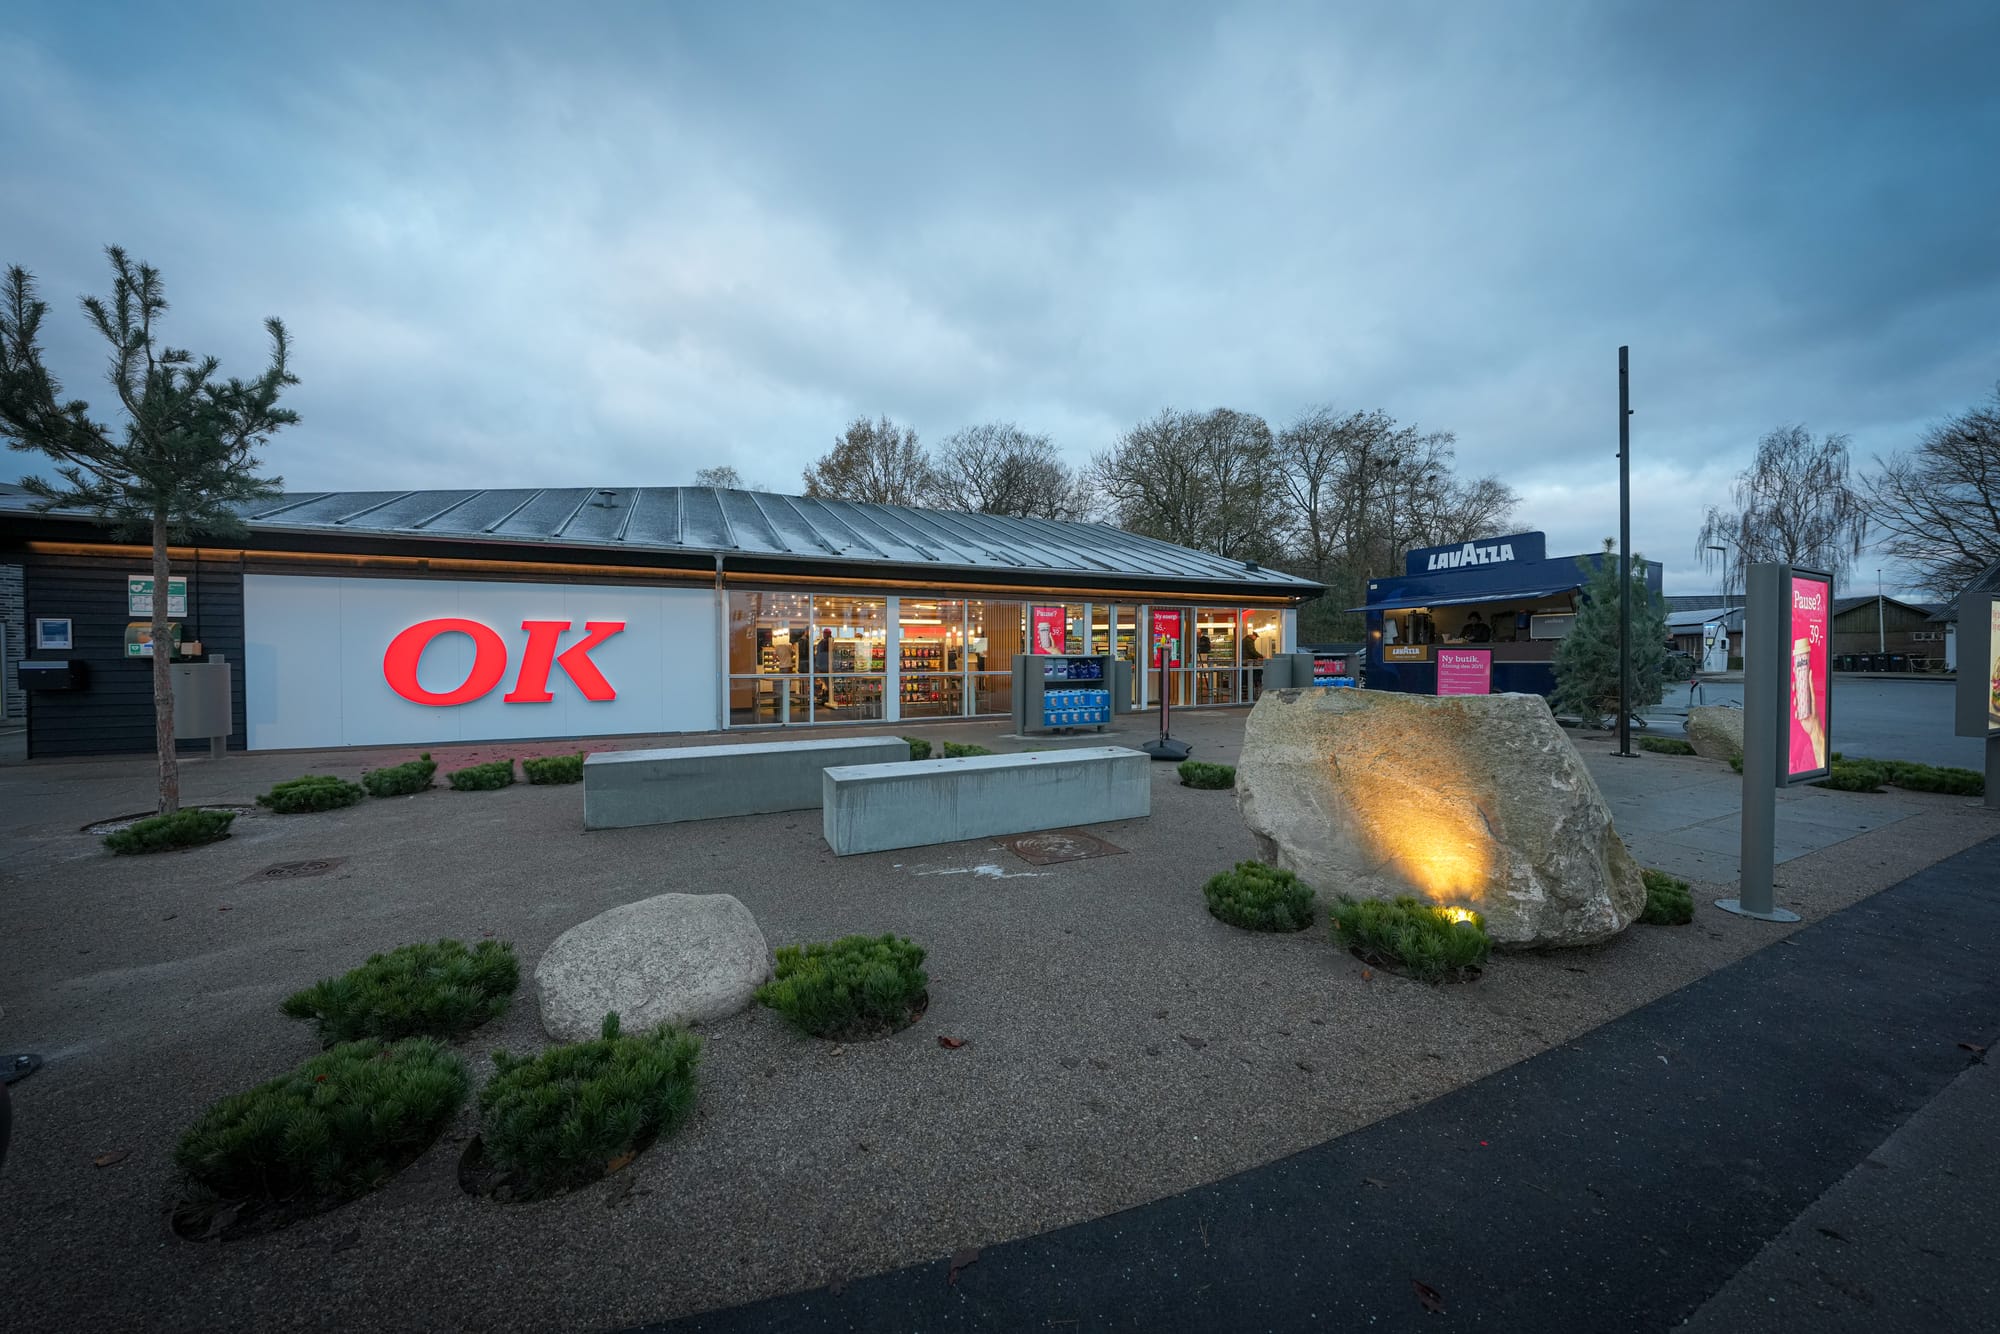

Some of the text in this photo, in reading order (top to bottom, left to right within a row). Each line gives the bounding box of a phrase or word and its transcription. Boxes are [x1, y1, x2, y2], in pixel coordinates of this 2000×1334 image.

[1427, 542, 1515, 570] LAVAZZA
[1794, 590, 1821, 611] Pause?
[1036, 609, 1058, 617] Pause?
[383, 618, 626, 706] OK
[1441, 655, 1480, 663] Ny butik.
